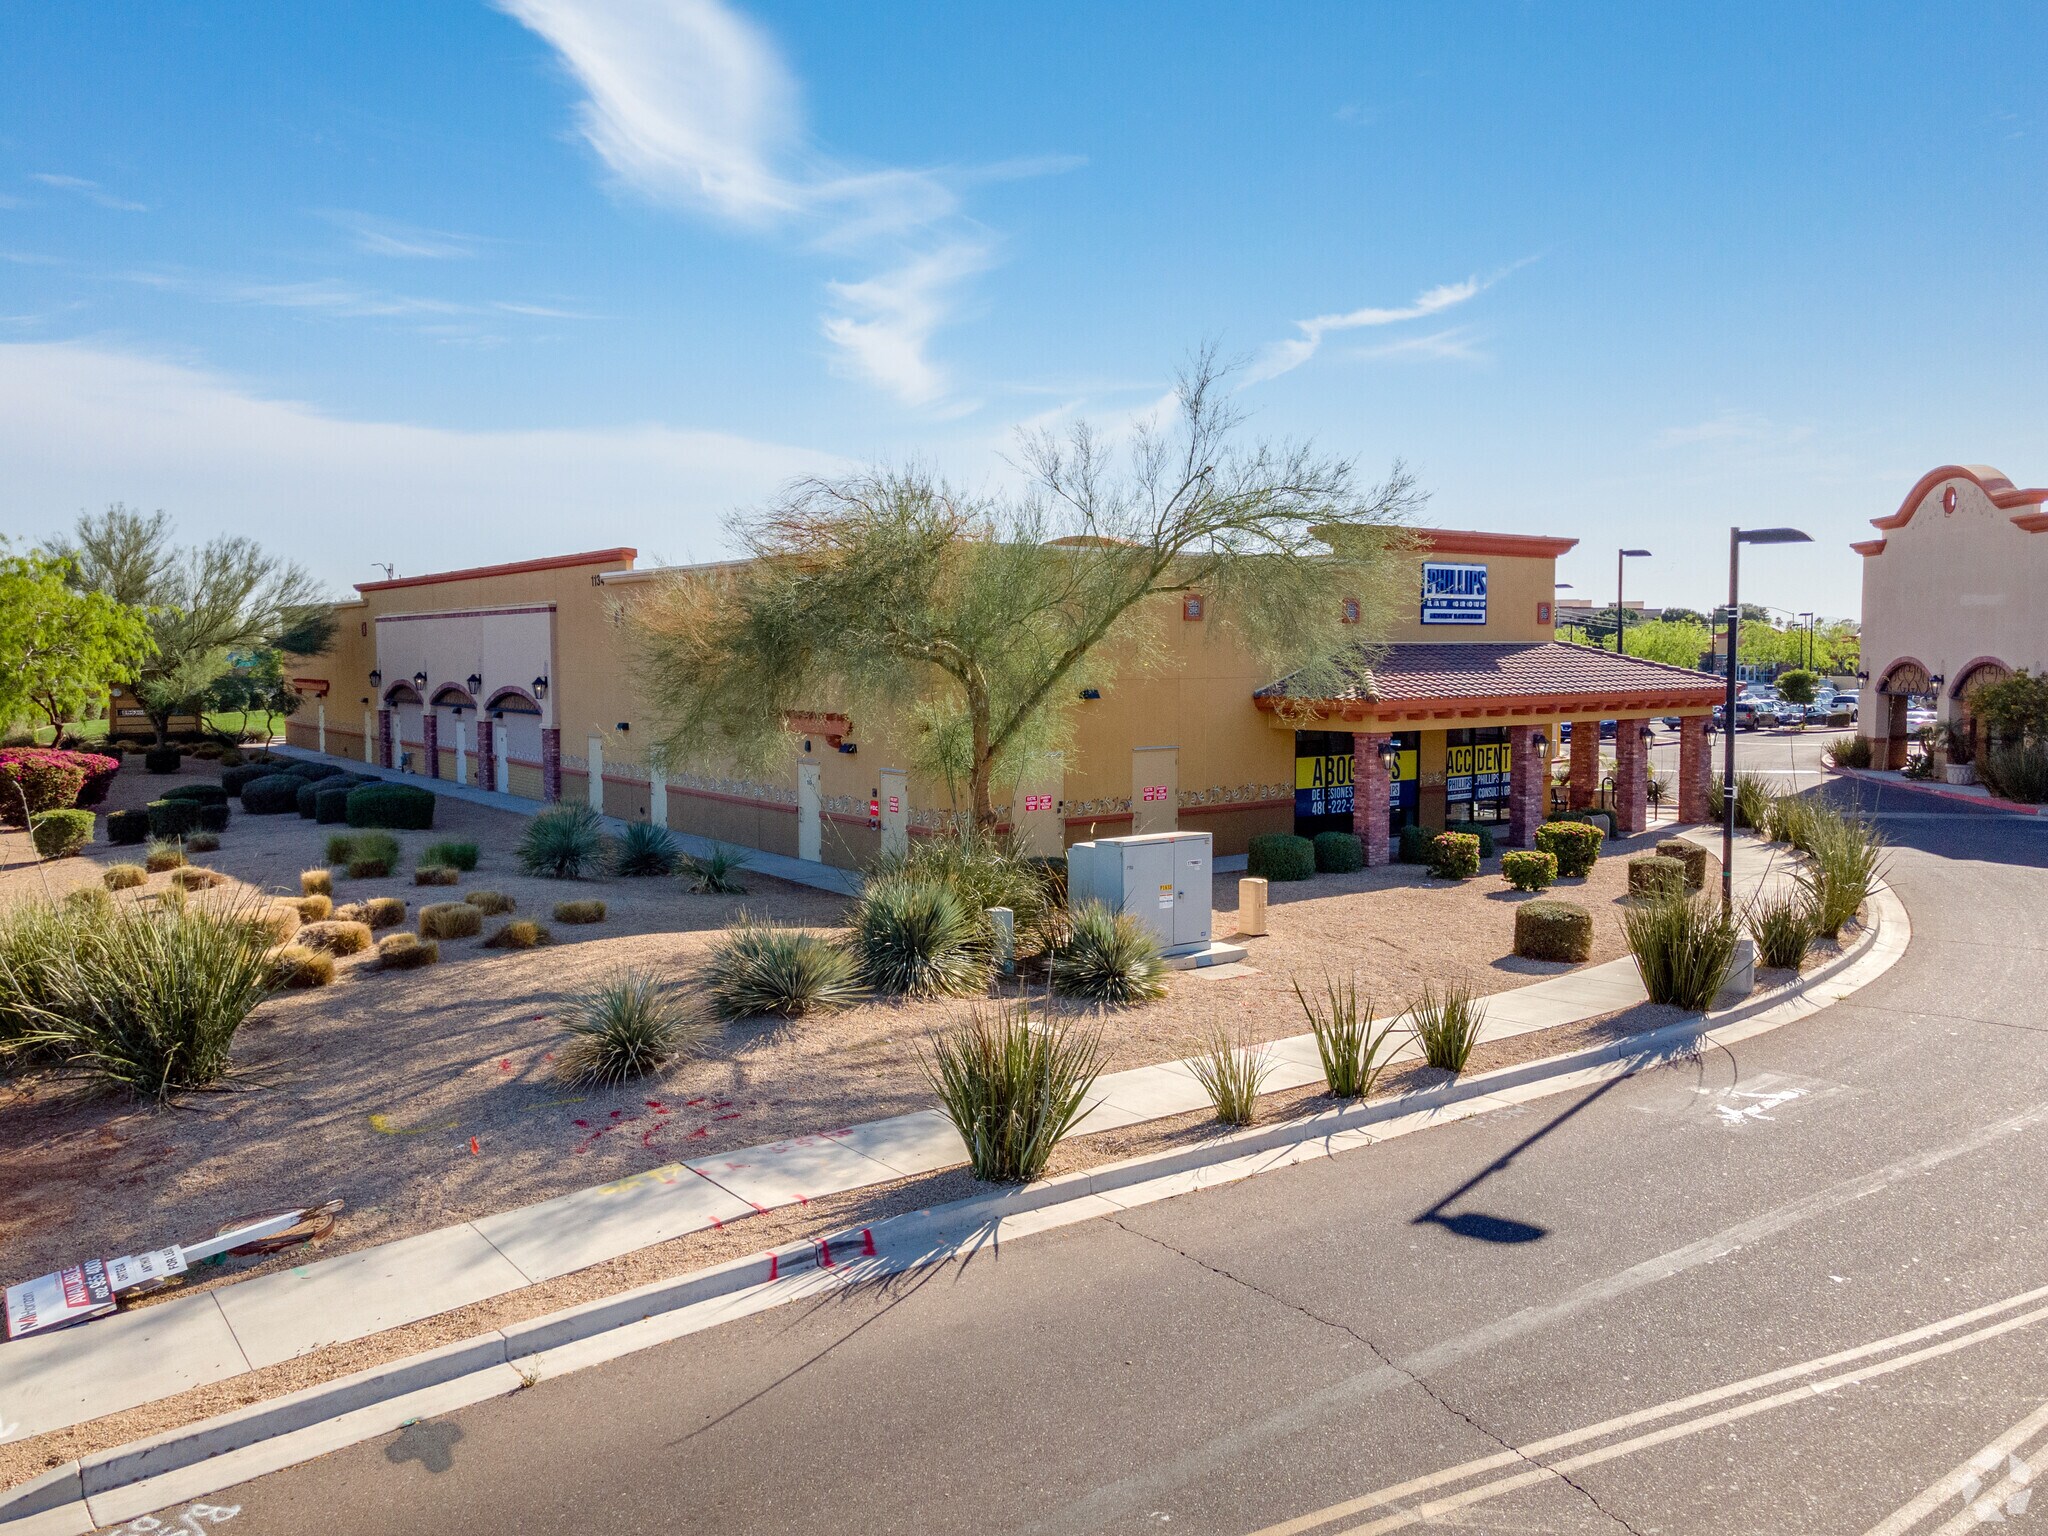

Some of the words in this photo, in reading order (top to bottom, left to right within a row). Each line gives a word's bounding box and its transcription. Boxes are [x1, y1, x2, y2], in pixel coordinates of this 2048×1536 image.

[1427, 569, 1487, 595] PHILLIPS
[1447, 746, 1510, 774] ACCDENT
[1448, 778, 1472, 791] PHILLIPS
[1311, 789, 1321, 801] DE
[166, 1257, 179, 1270] FOR
[63, 1265, 87, 1305] AVAILABLE
